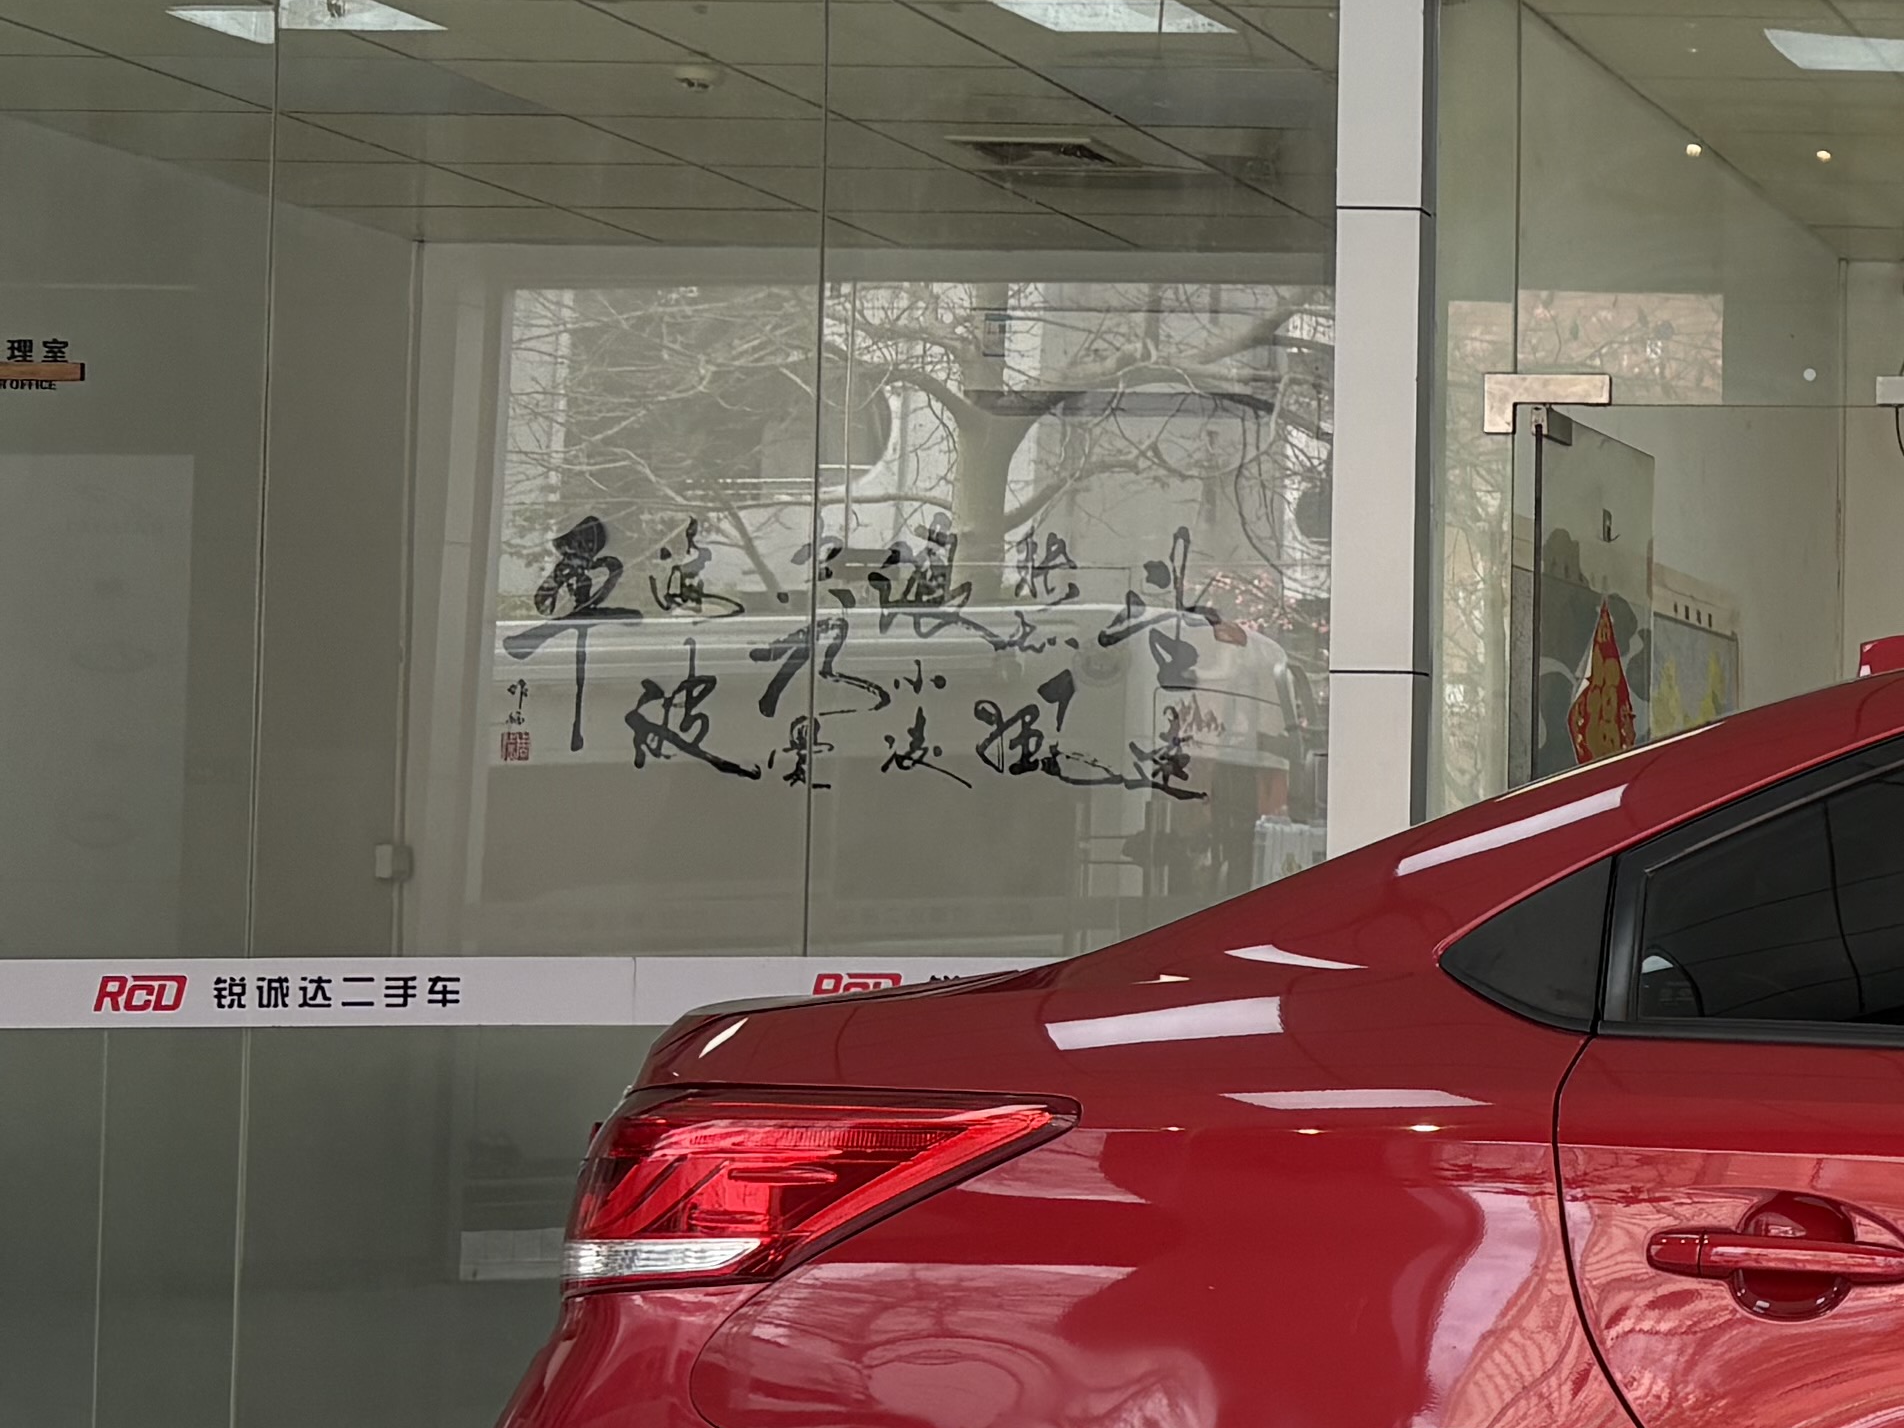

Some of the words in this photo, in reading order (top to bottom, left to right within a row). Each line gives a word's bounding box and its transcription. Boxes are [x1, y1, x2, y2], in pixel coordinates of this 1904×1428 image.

[6, 337, 69, 363] 理室
[92, 974, 187, 1014] RCD
[212, 974, 462, 1008] 锐诚达二手车
